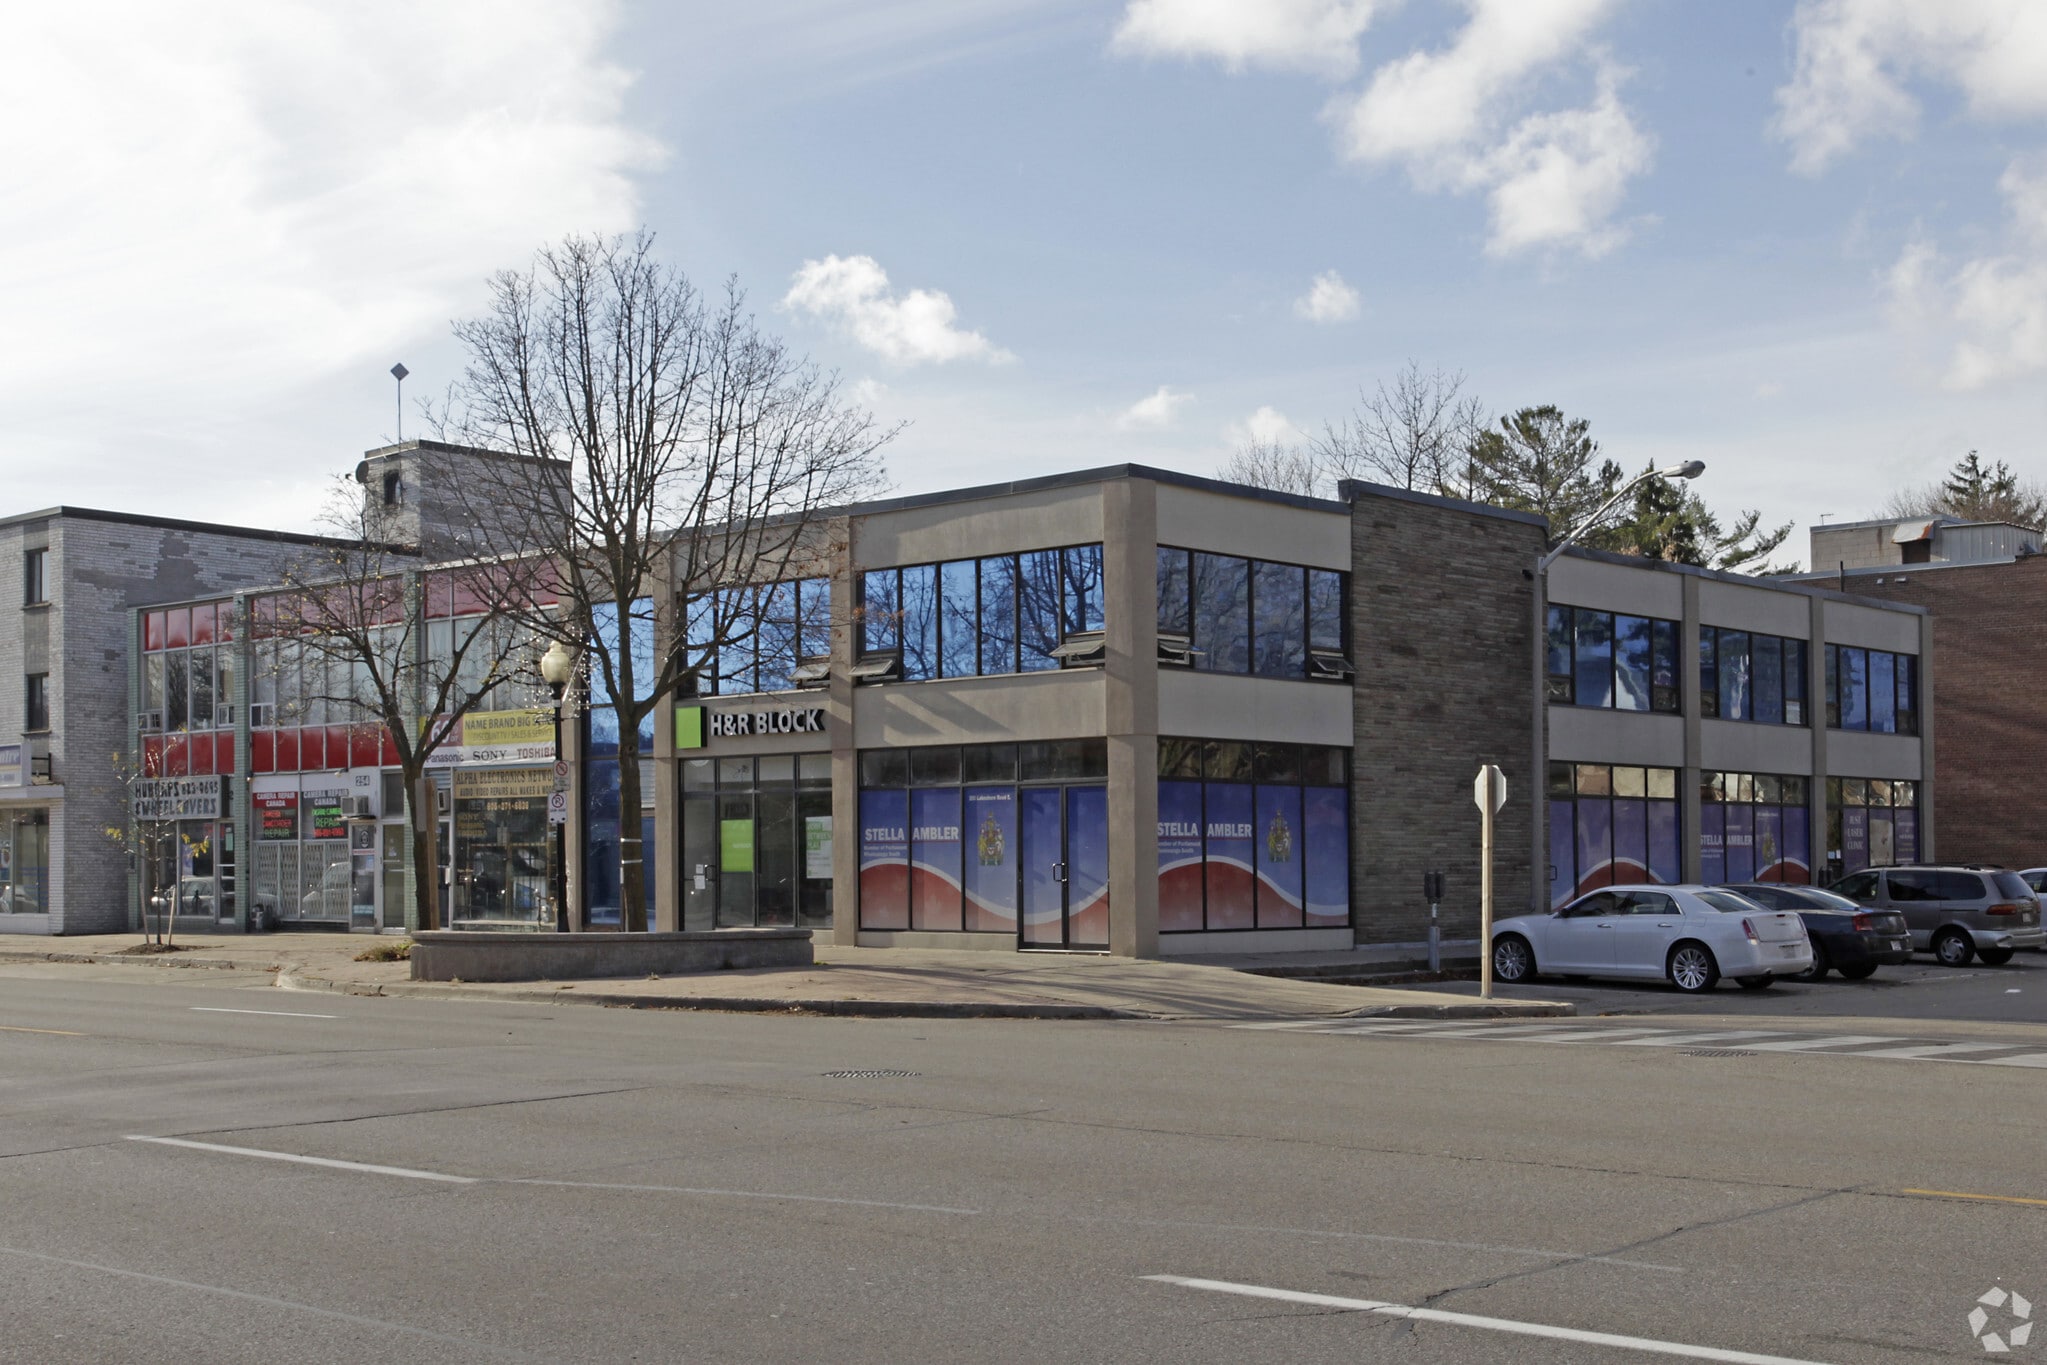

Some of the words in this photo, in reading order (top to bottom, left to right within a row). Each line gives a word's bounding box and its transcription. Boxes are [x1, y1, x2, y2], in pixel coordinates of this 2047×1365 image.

[465, 720, 487, 730] NAME
[488, 718, 516, 728] BRAND
[517, 717, 531, 727] BIG
[710, 714, 750, 736] H&R
[756, 709, 822, 734] BLOCK
[472, 750, 508, 760] SONY
[517, 747, 555, 759] TOSHIBA
[480, 769, 525, 784] ELECTRONICS
[527, 768, 554, 782] NETWO
[864, 827, 905, 841] STELLA
[912, 826, 960, 840] AMBLER
[1157, 822, 1199, 837] STELLA
[1207, 823, 1253, 838] AMBLER
[1727, 834, 1753, 846] AMBLER
